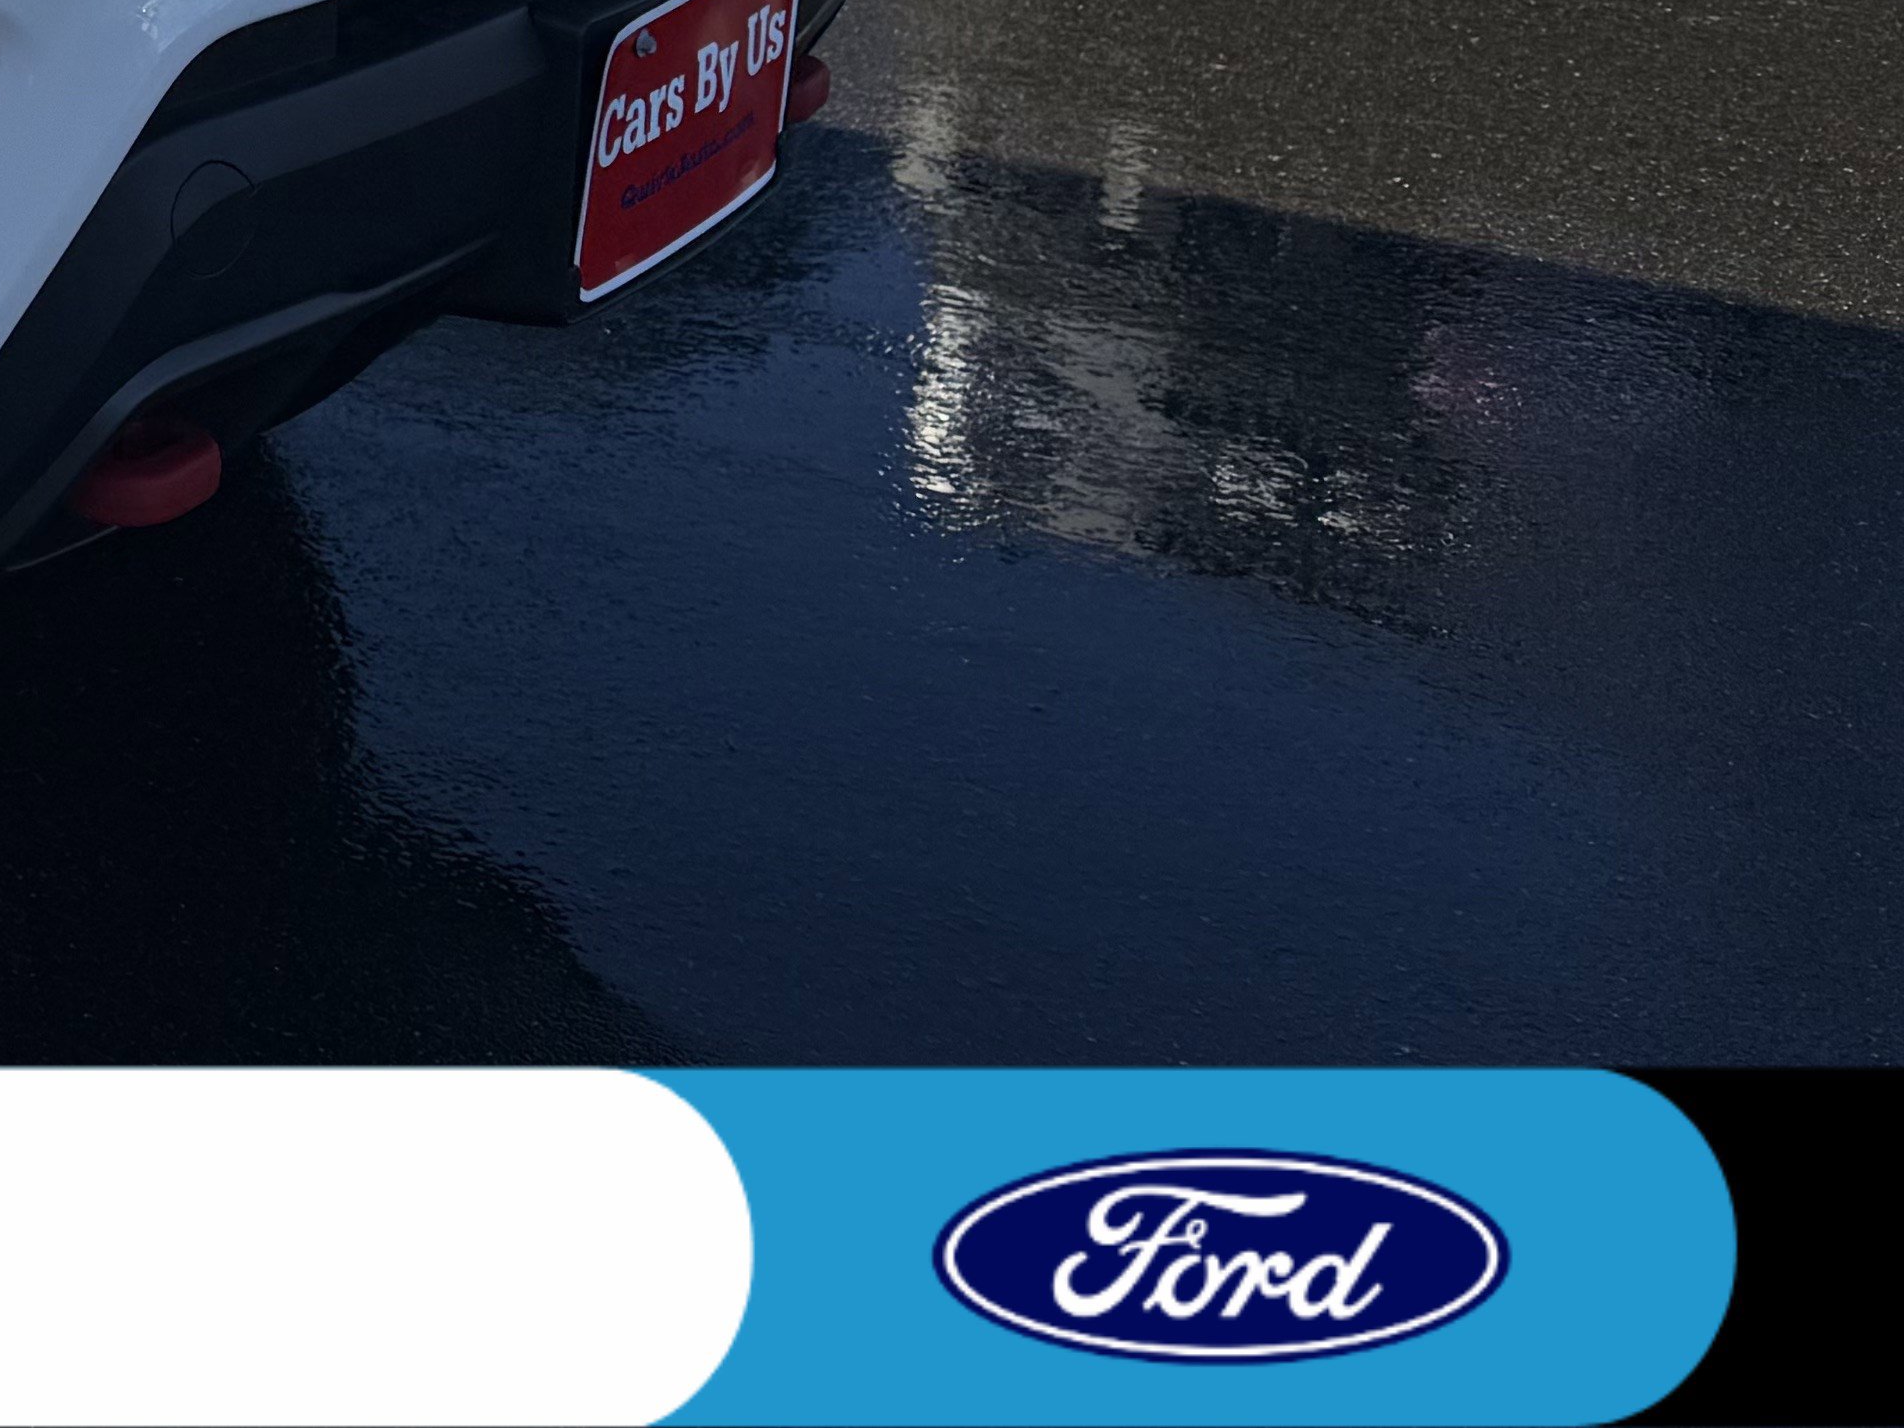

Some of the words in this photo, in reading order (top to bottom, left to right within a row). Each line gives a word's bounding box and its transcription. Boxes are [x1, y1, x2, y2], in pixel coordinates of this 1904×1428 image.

[598, 74, 686, 169] Cars
[694, 40, 739, 114] By
[747, 3, 787, 76] Us
